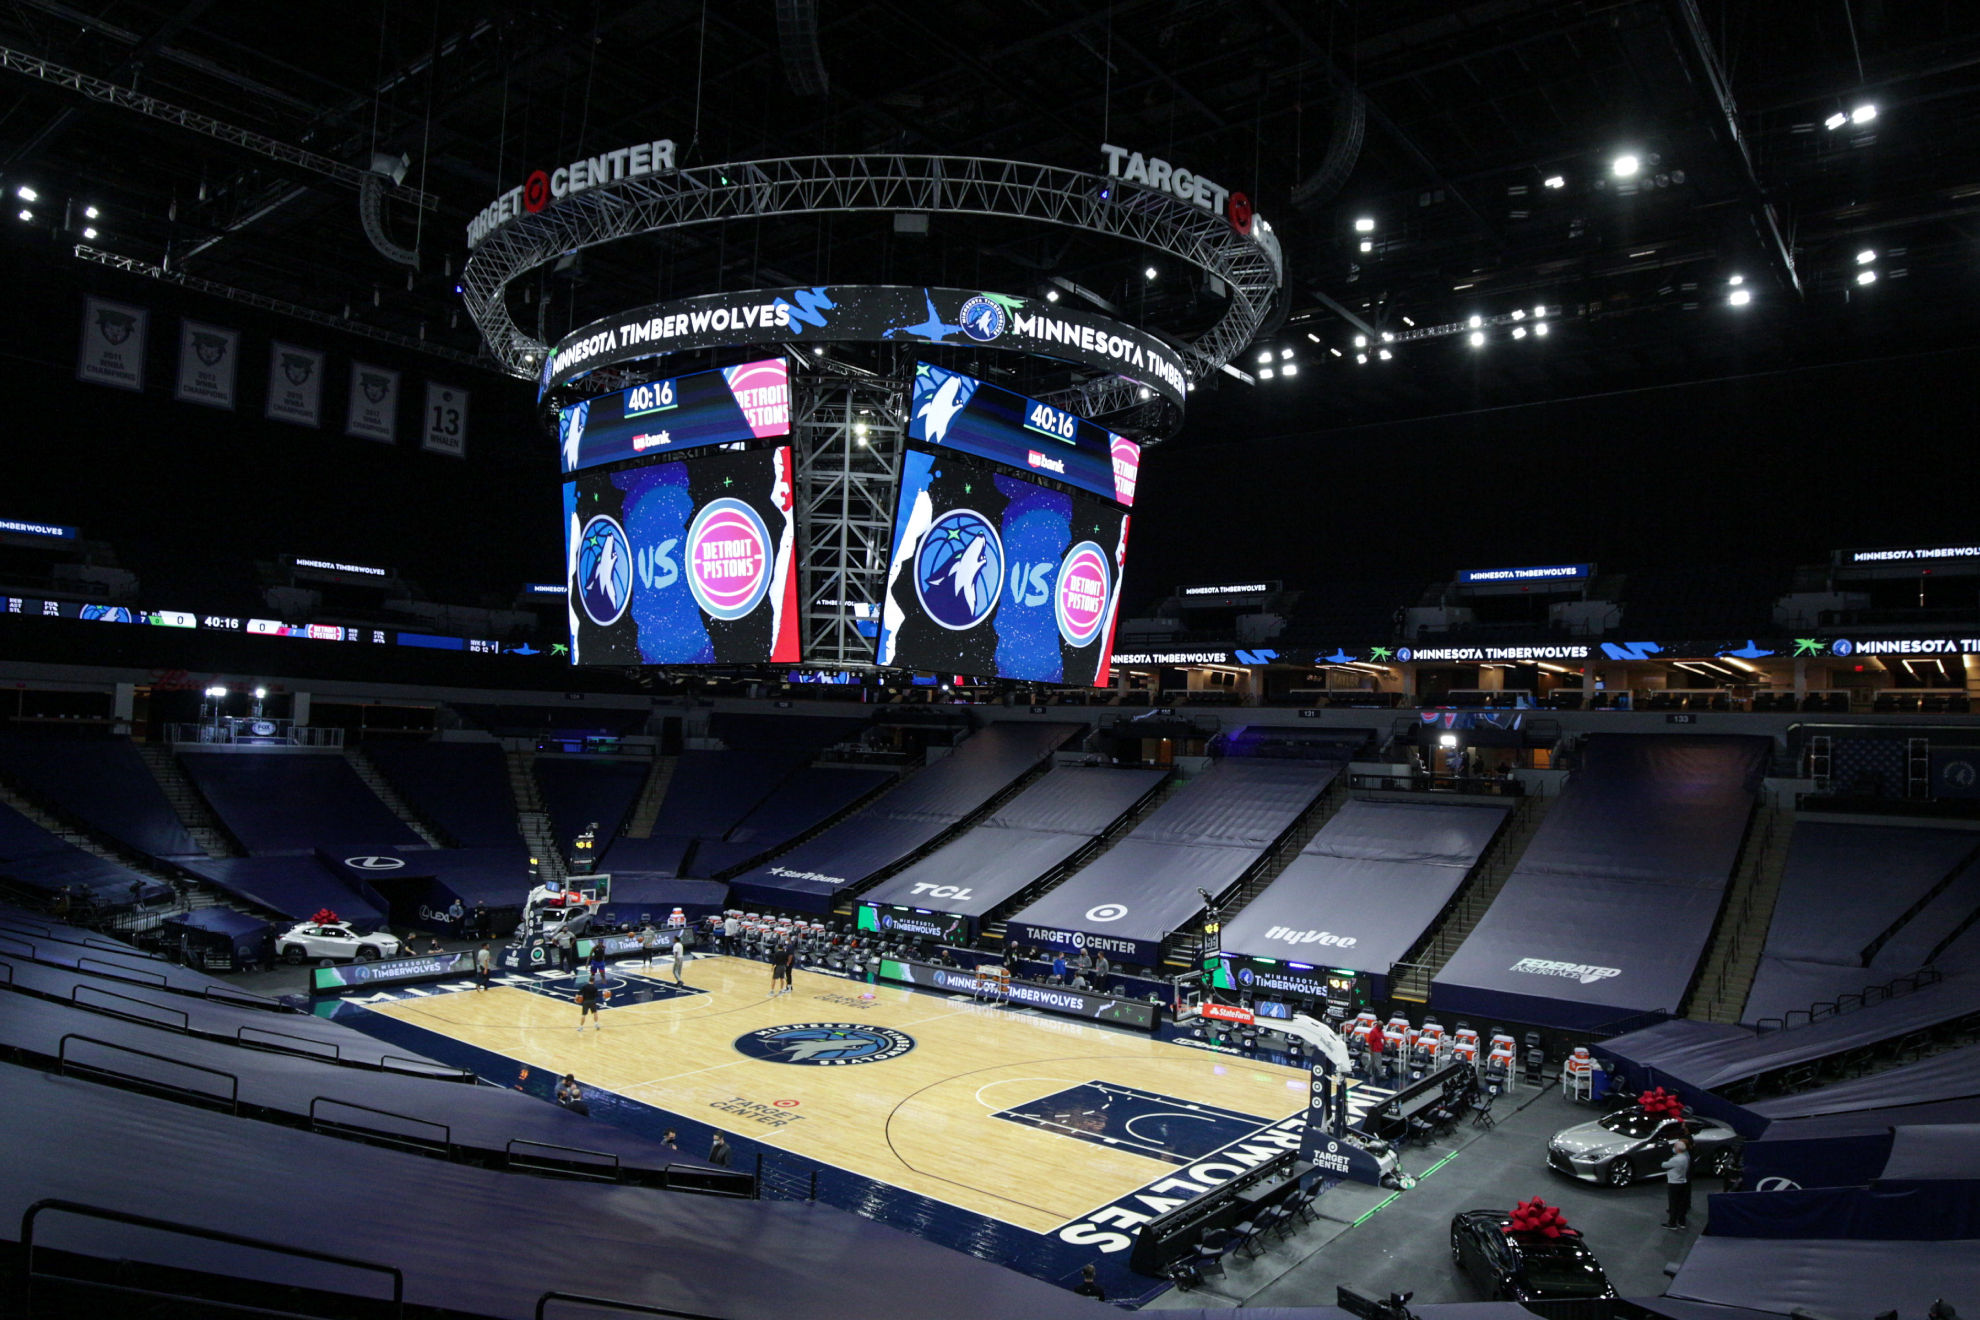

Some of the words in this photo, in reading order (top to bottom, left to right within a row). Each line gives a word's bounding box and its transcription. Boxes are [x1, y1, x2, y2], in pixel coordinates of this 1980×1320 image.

[1101, 142, 1229, 216] TARGET
[467, 184, 525, 249] TARGET
[550, 138, 678, 198] CENTER
[551, 331, 617, 377] MINNESOTA
[619, 302, 791, 347] TIMBERWOLVES
[1013, 312, 1144, 368] MINNESOTA
[86, 364, 136, 381] CHAMPIONS
[628, 380, 674, 411] 40:16
[432, 406, 459, 436] 13
[1030, 403, 1075, 438] 40:16
[430, 434, 459, 448] WHALEN
[702, 538, 752, 560] DETROIT
[1854, 550, 1914, 562] MINNESOTA
[296, 559, 335, 570] MINNESOTA
[335, 563, 385, 576] TIMBERWOLVES
[638, 538, 679, 590] VS
[702, 558, 754, 580] PISTONS
[1470, 570, 1514, 581] MINNESOTA
[1515, 567, 1577, 579] TIMBERWOLVES
[1010, 561, 1054, 608] VS
[1070, 575, 1102, 595] DETROIT
[1186, 587, 1219, 595] MINNESOTA
[1219, 584, 1266, 593] TIMBERWOLVES
[1067, 591, 1100, 613] PISTONS
[177, 616, 184, 625] 0
[204, 616, 239, 629] 40:16
[259, 623, 266, 632] 0
[1413, 648, 1483, 660] MINNESOTA
[1485, 646, 1588, 659] TIMBERWOLVES
[1856, 639, 1957, 654] MINNESOTA
[1153, 652, 1226, 664] TIMBERWOLVES
[1673, 715, 1689, 723] 133
[910, 882, 975, 901] TCL
[893, 920, 941, 937] TIMBERWOLVES
[899, 918, 935, 927] MINNESOTA
[1026, 927, 1072, 943] TARGET
[1086, 937, 1136, 955] CENTER
[1265, 925, 1357, 949] HyVee
[372, 962, 441, 979] TIMBERWOLVES
[381, 960, 431, 969] MINNESOTA
[1509, 964, 1580, 980] INSURANCE
[1516, 957, 1622, 978] FEDERATED
[1255, 975, 1327, 997] TIMBERWOLVES
[1265, 973, 1318, 986] MINNESOTA
[755, 1023, 876, 1036] MINNESOTA
[709, 1101, 787, 1127] CENTER
[729, 1097, 806, 1121] TARGET
[1312, 1158, 1349, 1173] CENTER
[1313, 1150, 1350, 1165] TARGET
